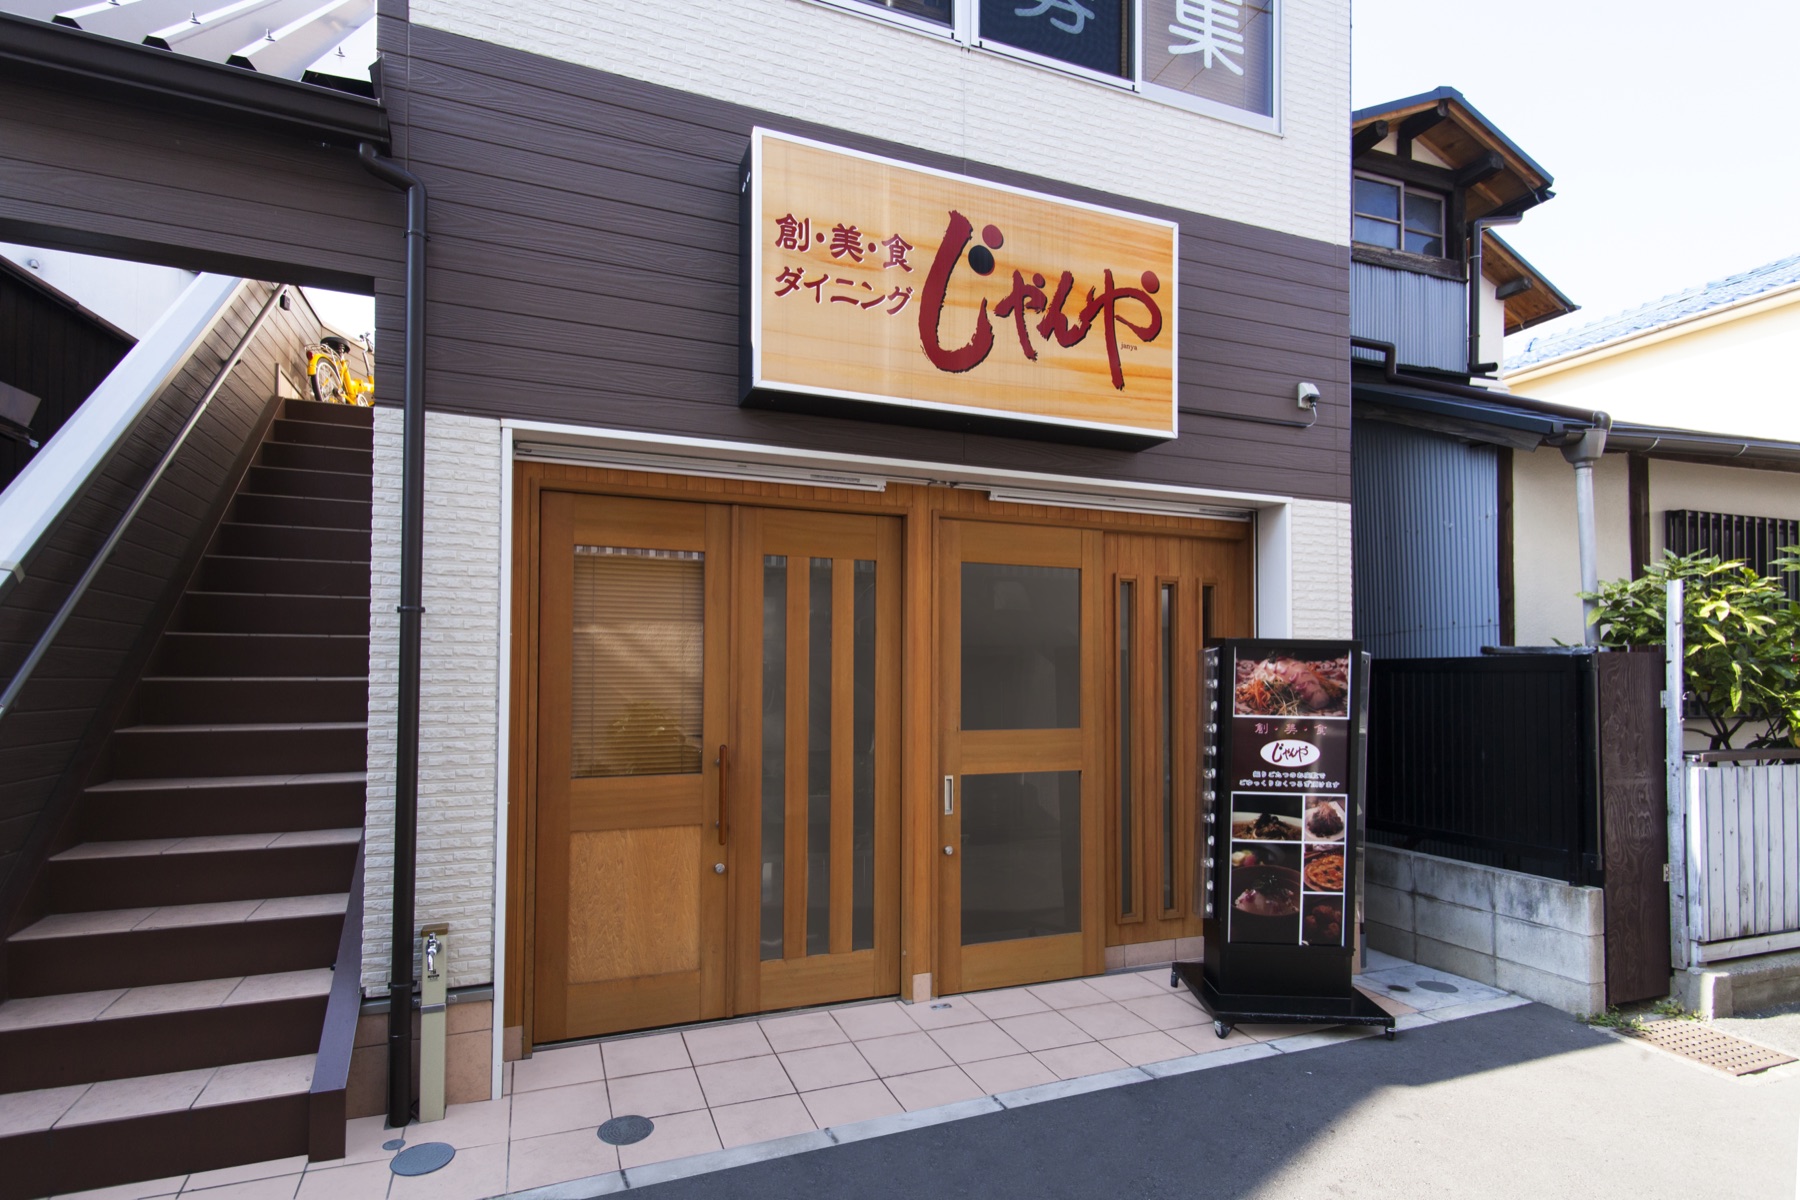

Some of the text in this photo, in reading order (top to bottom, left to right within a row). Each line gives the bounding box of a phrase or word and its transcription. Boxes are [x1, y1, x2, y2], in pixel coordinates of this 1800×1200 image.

[775, 213, 914, 273] 創・美・食
[775, 266, 914, 316] ダイニング
[919, 210, 1162, 391] じゃんや
[1120, 342, 1138, 351] janya
[1271, 742, 1309, 763] じゃんや
